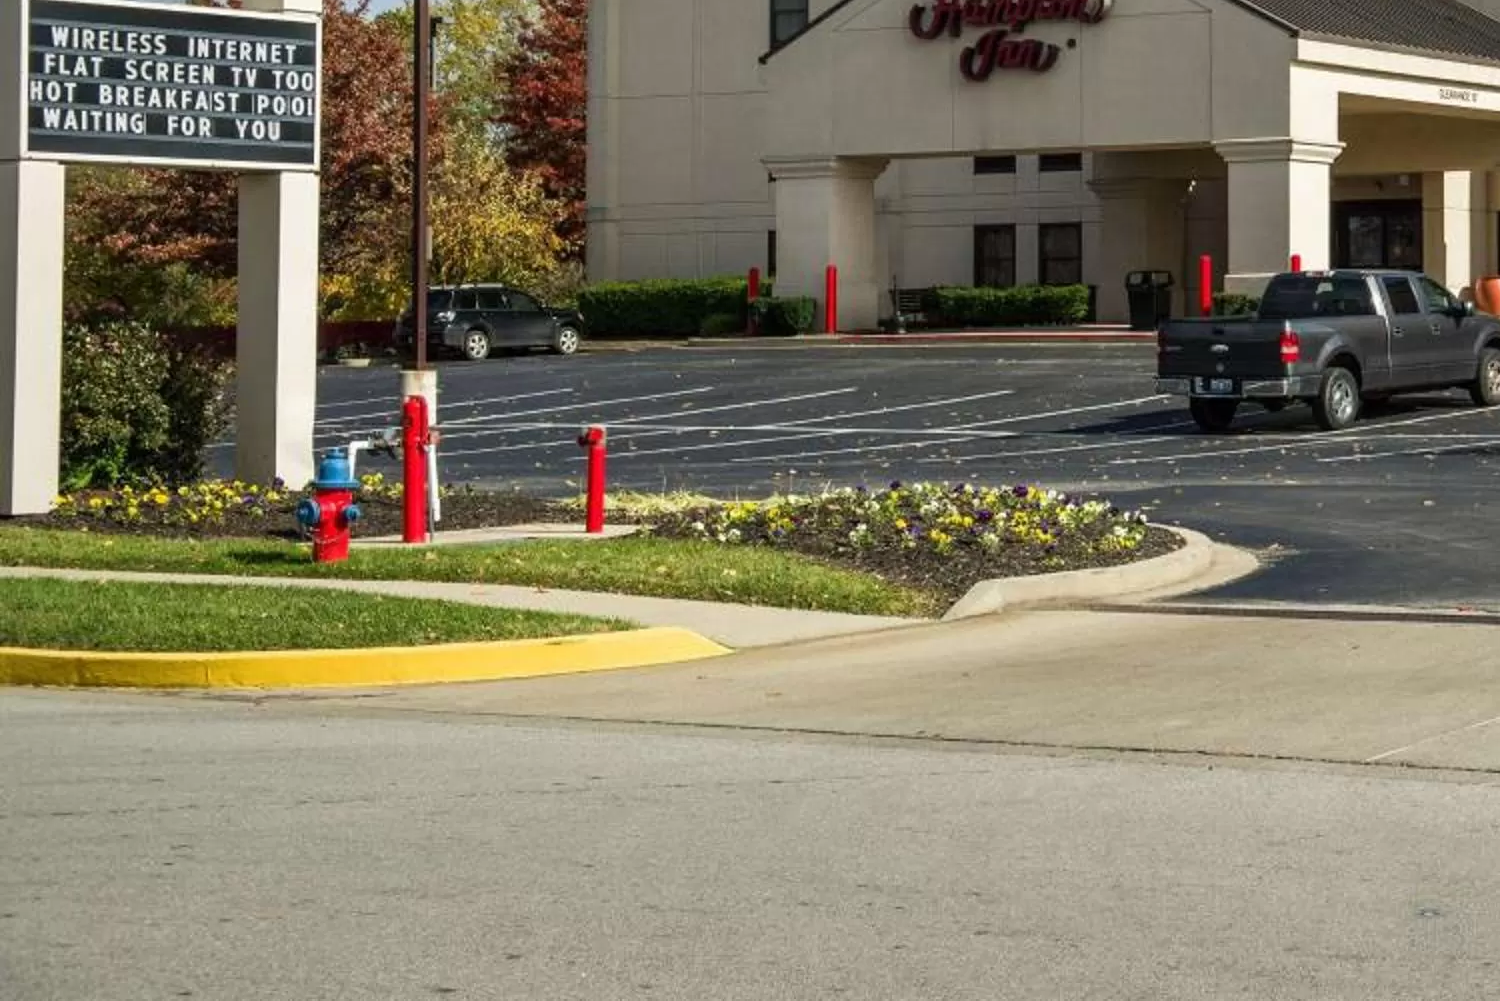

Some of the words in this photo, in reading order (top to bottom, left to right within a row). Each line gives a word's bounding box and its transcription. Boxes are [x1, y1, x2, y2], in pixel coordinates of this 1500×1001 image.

[51, 25, 168, 55] WIRELESS
[187, 37, 297, 64] INTERNET
[960, 29, 1062, 82] Inn
[43, 53, 103, 78] FLAT
[124, 59, 215, 84] SCREEN
[232, 67, 257, 87] TV
[271, 70, 313, 91] TOO
[30, 80, 77, 102] HOT
[99, 84, 240, 113] BREAKFAST
[43, 108, 145, 135] WAITING
[167, 117, 212, 137] FOR
[236, 121, 281, 141] YOU
